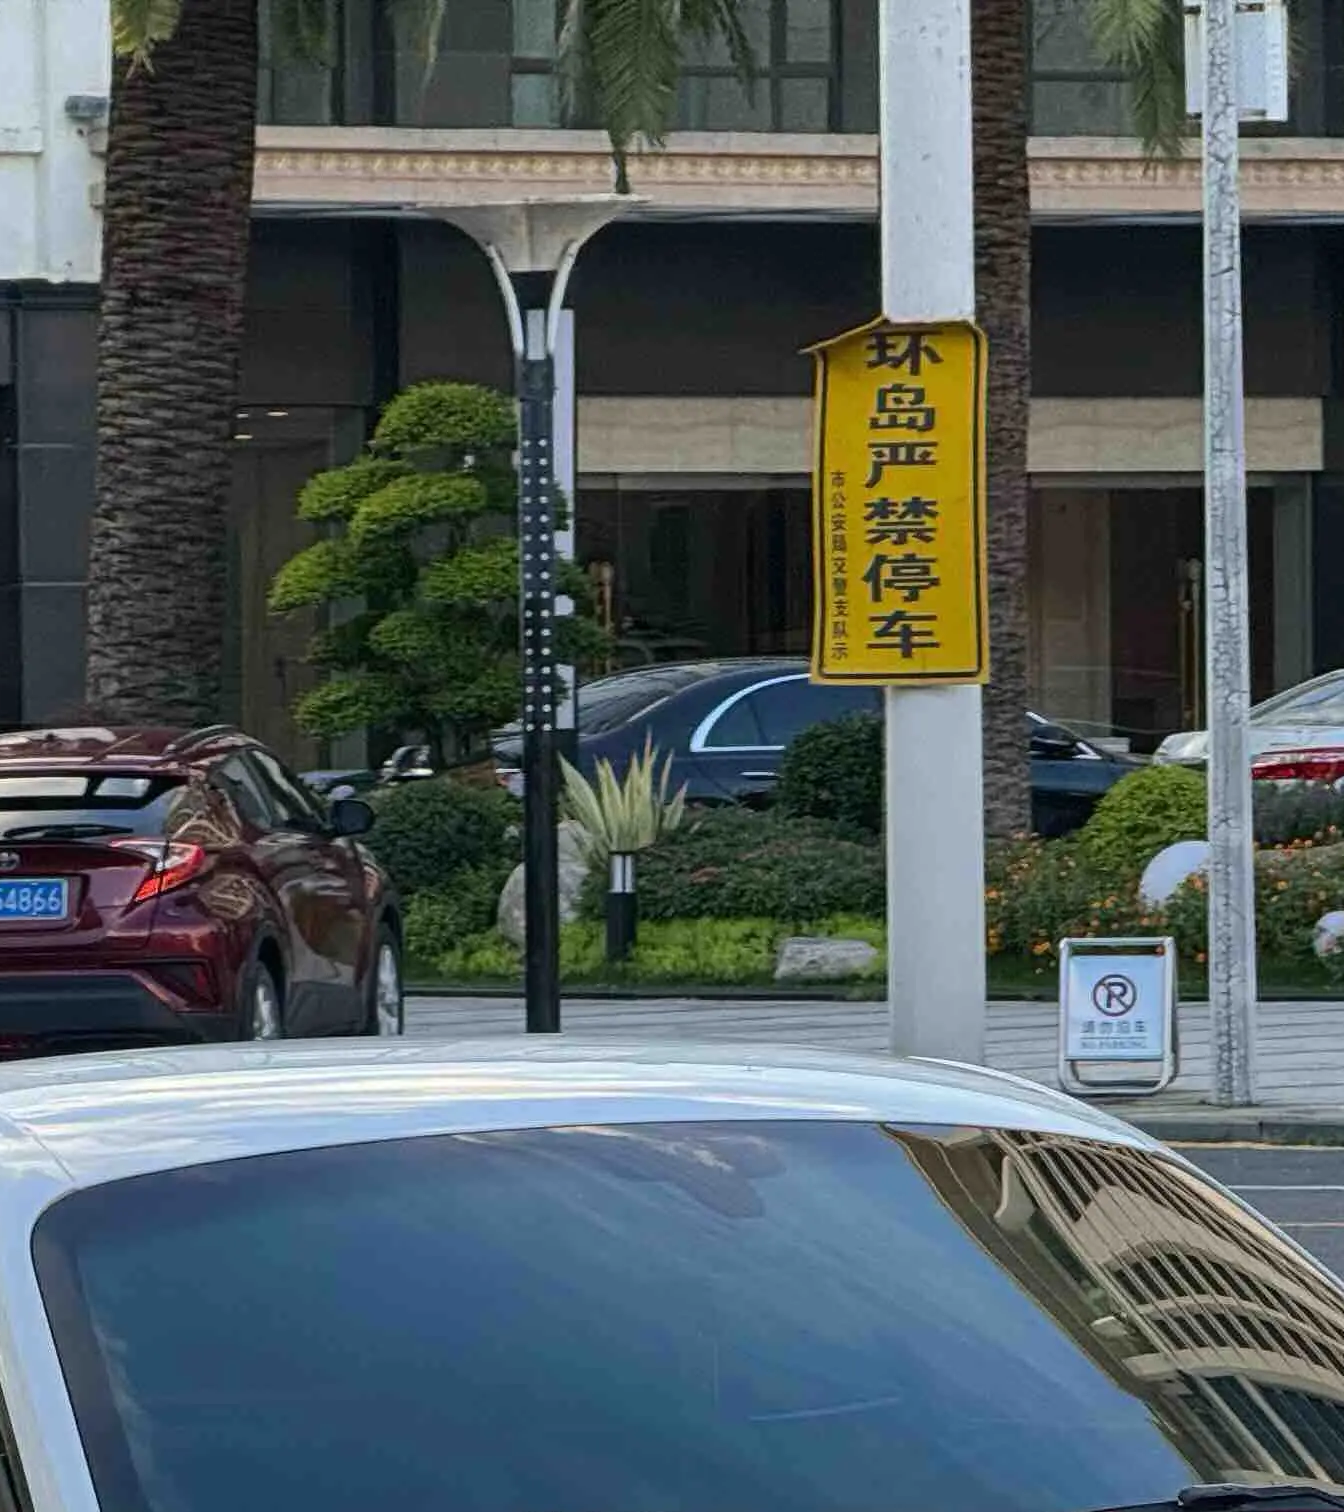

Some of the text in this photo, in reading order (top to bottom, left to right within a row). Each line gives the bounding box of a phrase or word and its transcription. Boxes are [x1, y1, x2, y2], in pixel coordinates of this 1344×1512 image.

[861, 331, 944, 659] 环岛严禁停车
